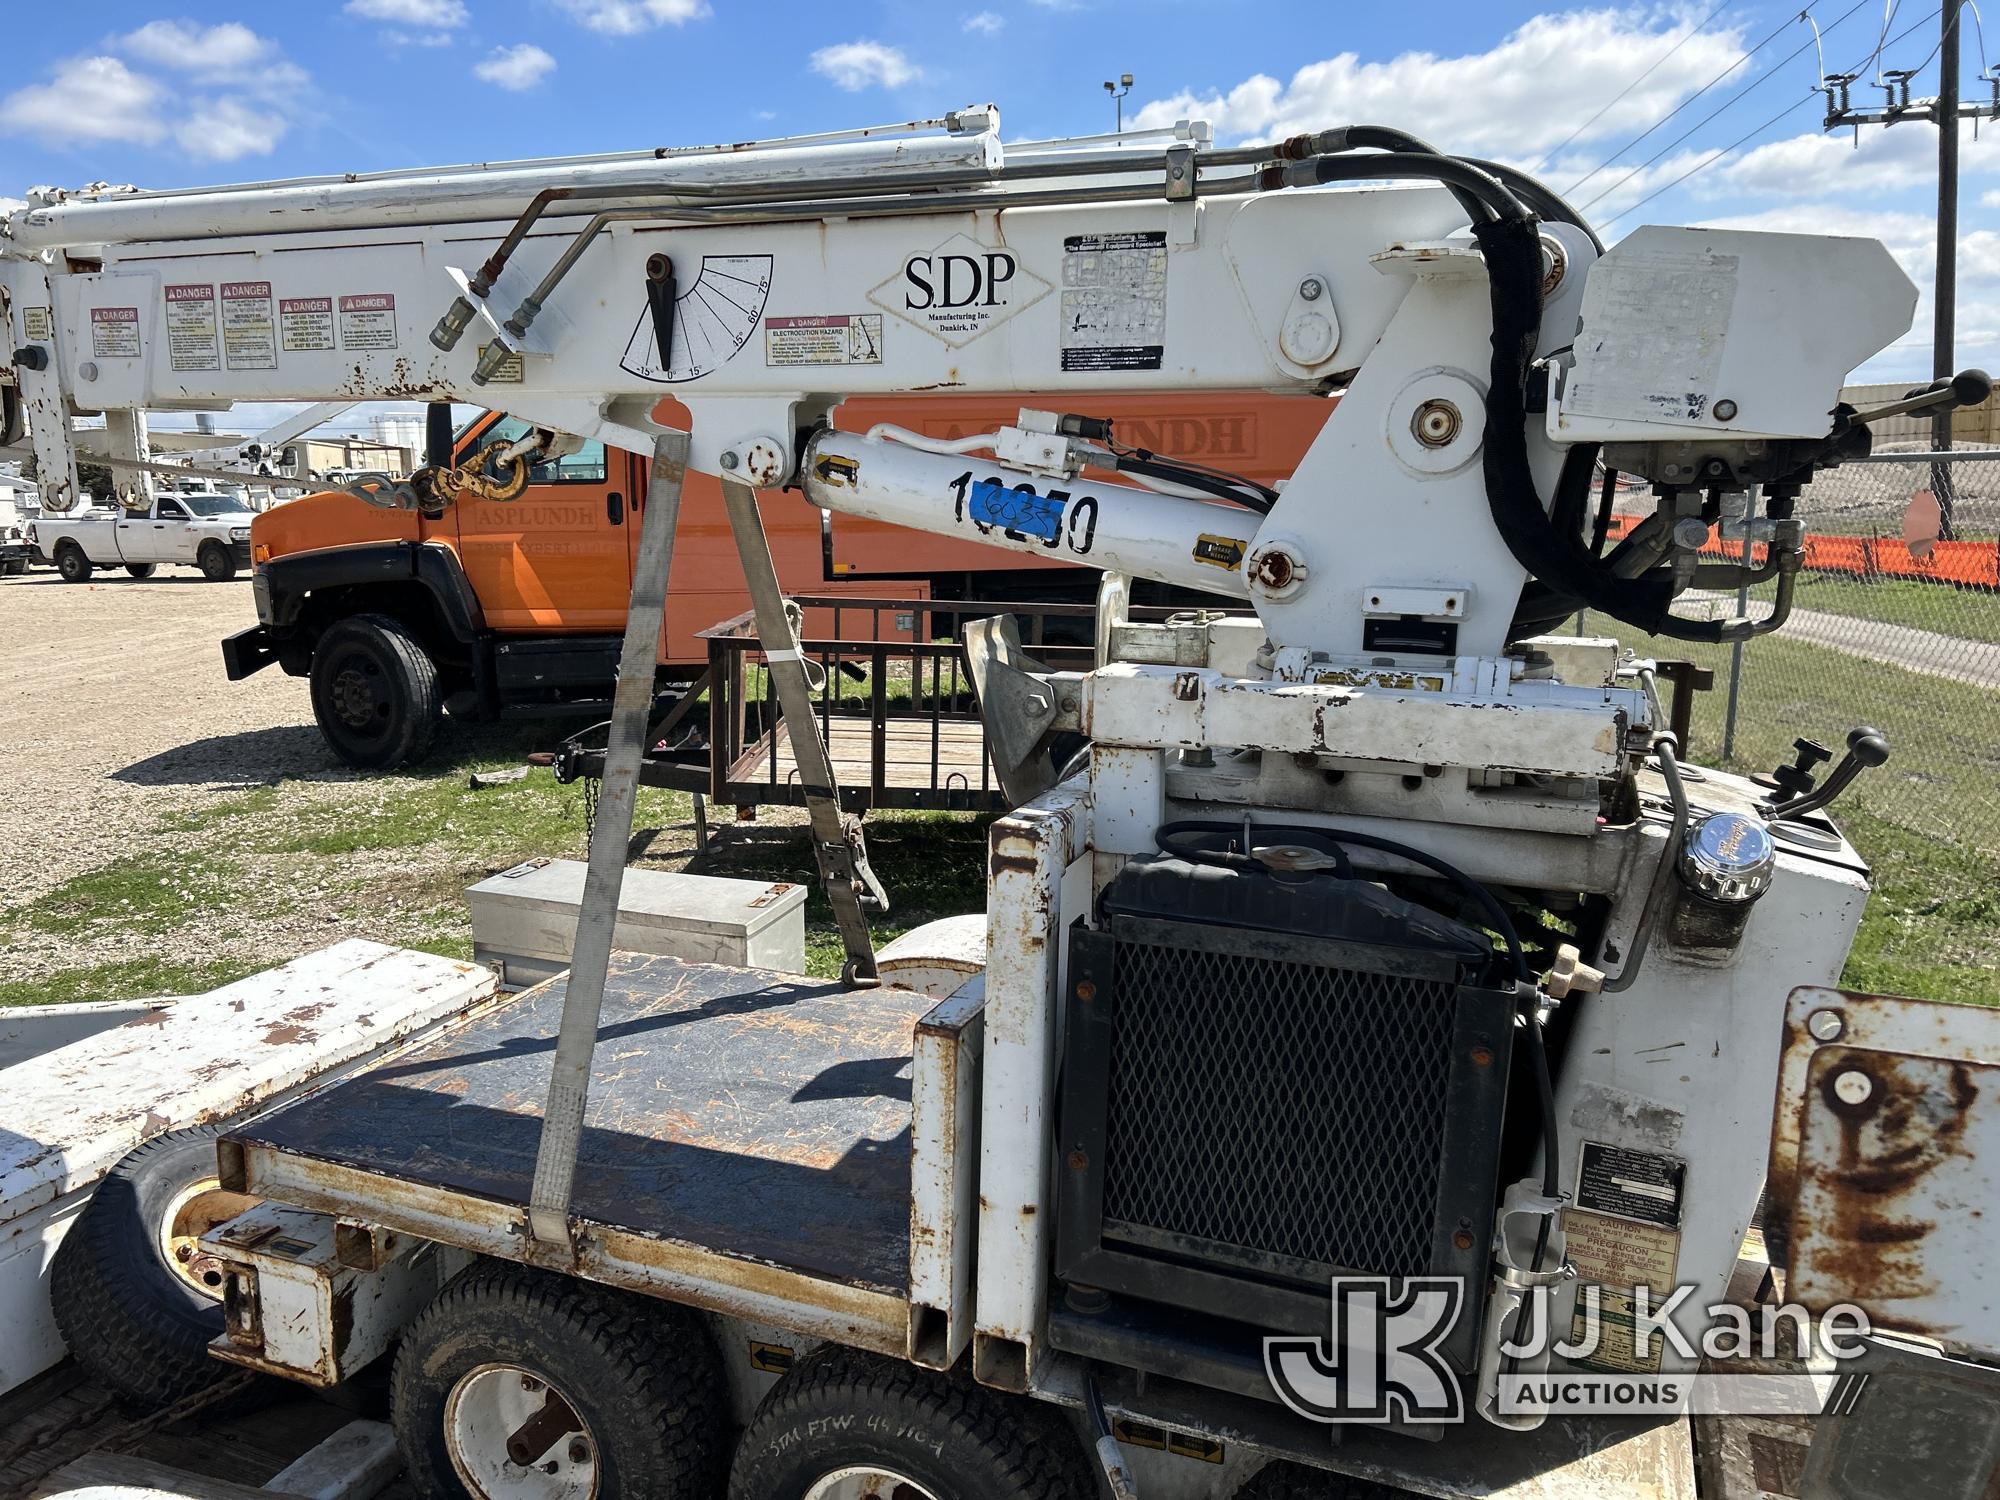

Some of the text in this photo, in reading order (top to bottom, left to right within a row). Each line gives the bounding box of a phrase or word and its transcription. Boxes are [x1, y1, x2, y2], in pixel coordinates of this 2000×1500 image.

[905, 253, 1016, 310] S.D.P.
[176, 287, 212, 299] DANGER
[231, 285, 269, 296] DANGER
[293, 301, 328, 311] DANGER
[355, 298, 387, 308] DANGER
[102, 310, 136, 320] DANGER
[928, 312, 977, 321] Manufacturing
[797, 319, 826, 327] DANGER
[939, 323, 969, 332] Dunkirk,
[479, 506, 594, 526] ASPLUNDH
[1599, 1220, 1641, 1234] CAUTION
[1580, 1223, 1602, 1232] LEVEL
[1604, 1228, 1622, 1237] MUST
[1635, 1234, 1668, 1246] CHECKED
[1576, 1242, 1595, 1252] NIVEL
[1596, 1246, 1610, 1255] DEL
[1587, 1237, 1649, 1256] PRECAUCION
[1605, 1261, 1626, 1272] AVIS
